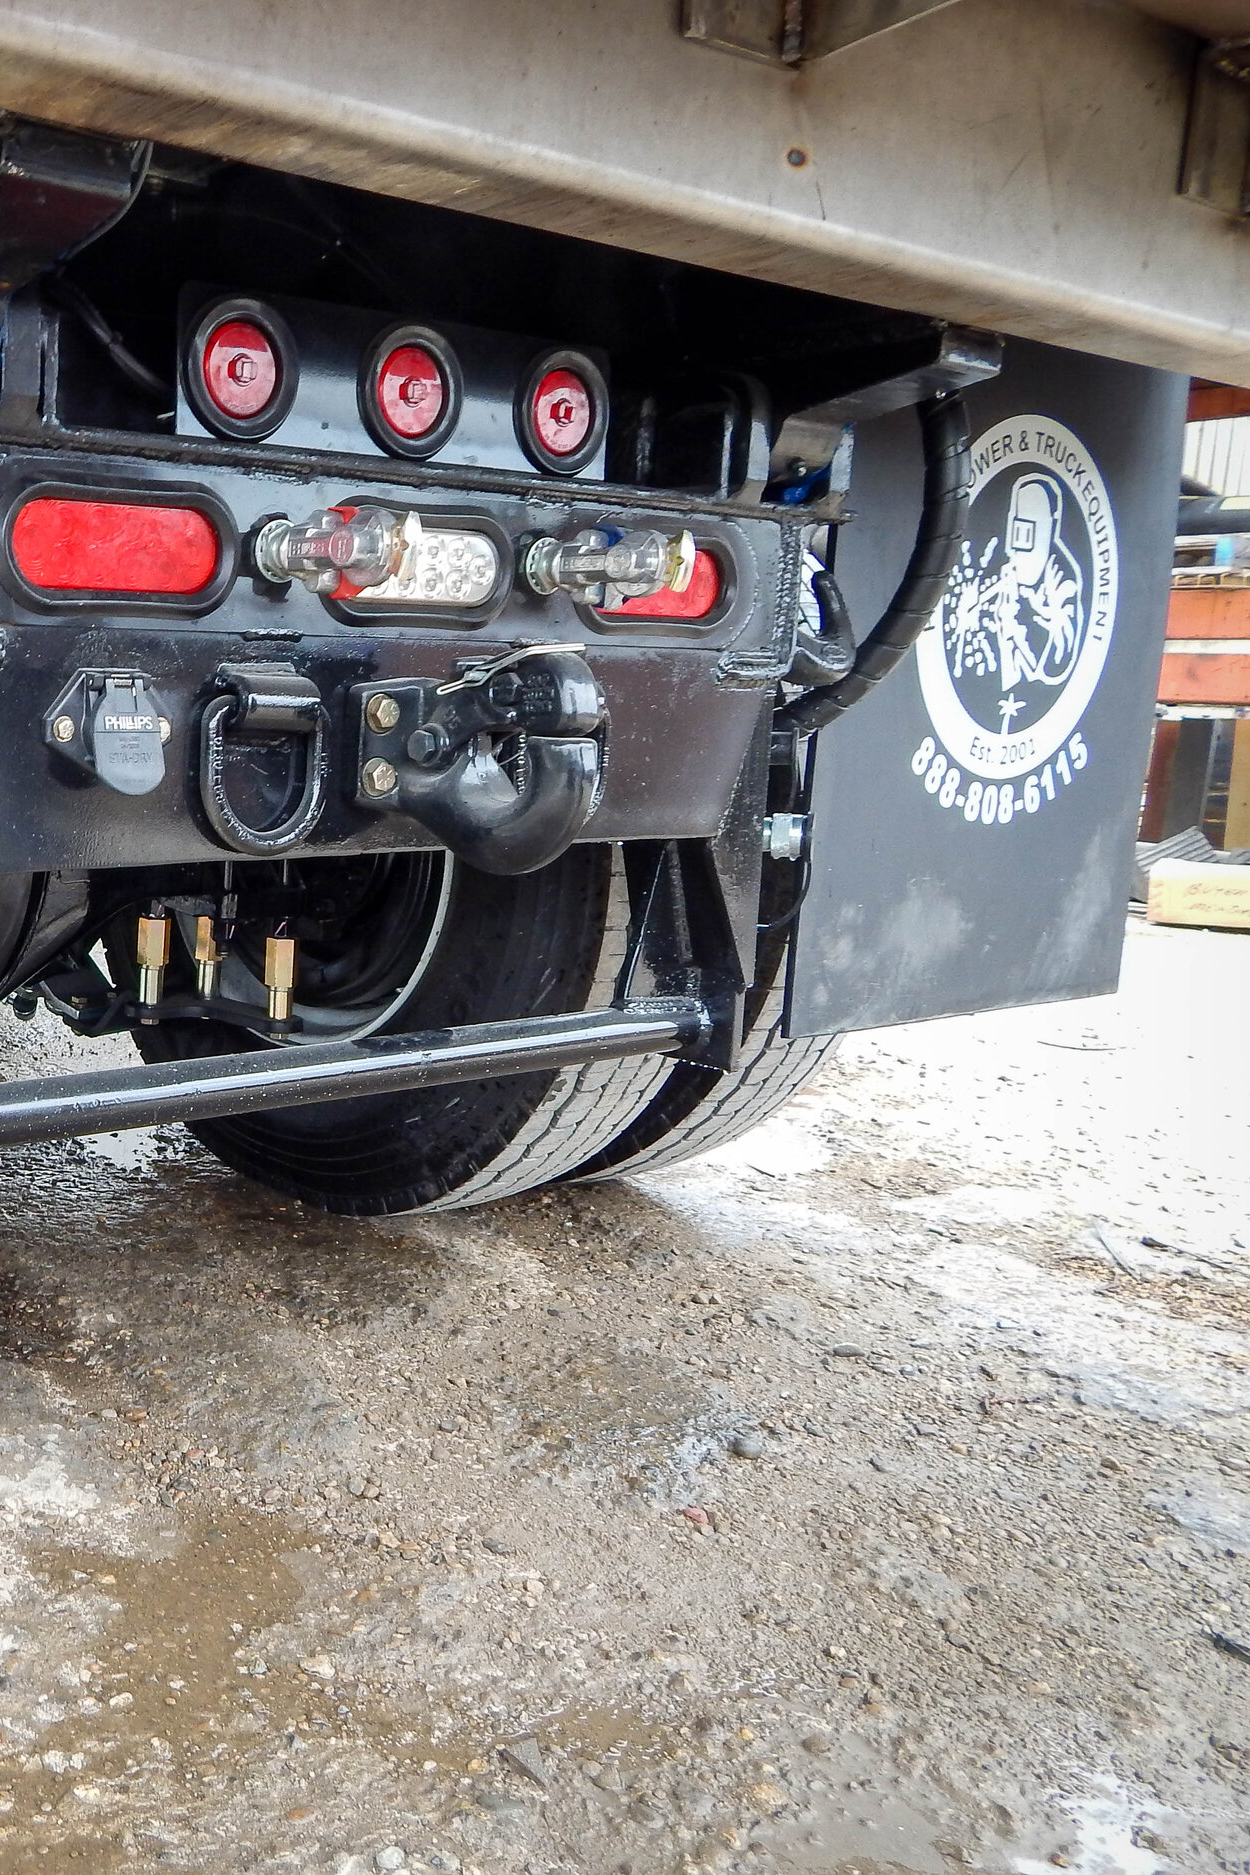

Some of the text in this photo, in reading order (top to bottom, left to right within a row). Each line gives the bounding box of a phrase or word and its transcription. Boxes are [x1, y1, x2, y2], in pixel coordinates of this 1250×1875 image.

[1018, 430, 1030, 452] &
[104, 715, 154, 731] PHILLIPS
[969, 736, 1036, 765] Est. 2001
[911, 732, 1088, 825] 888-808-6115
